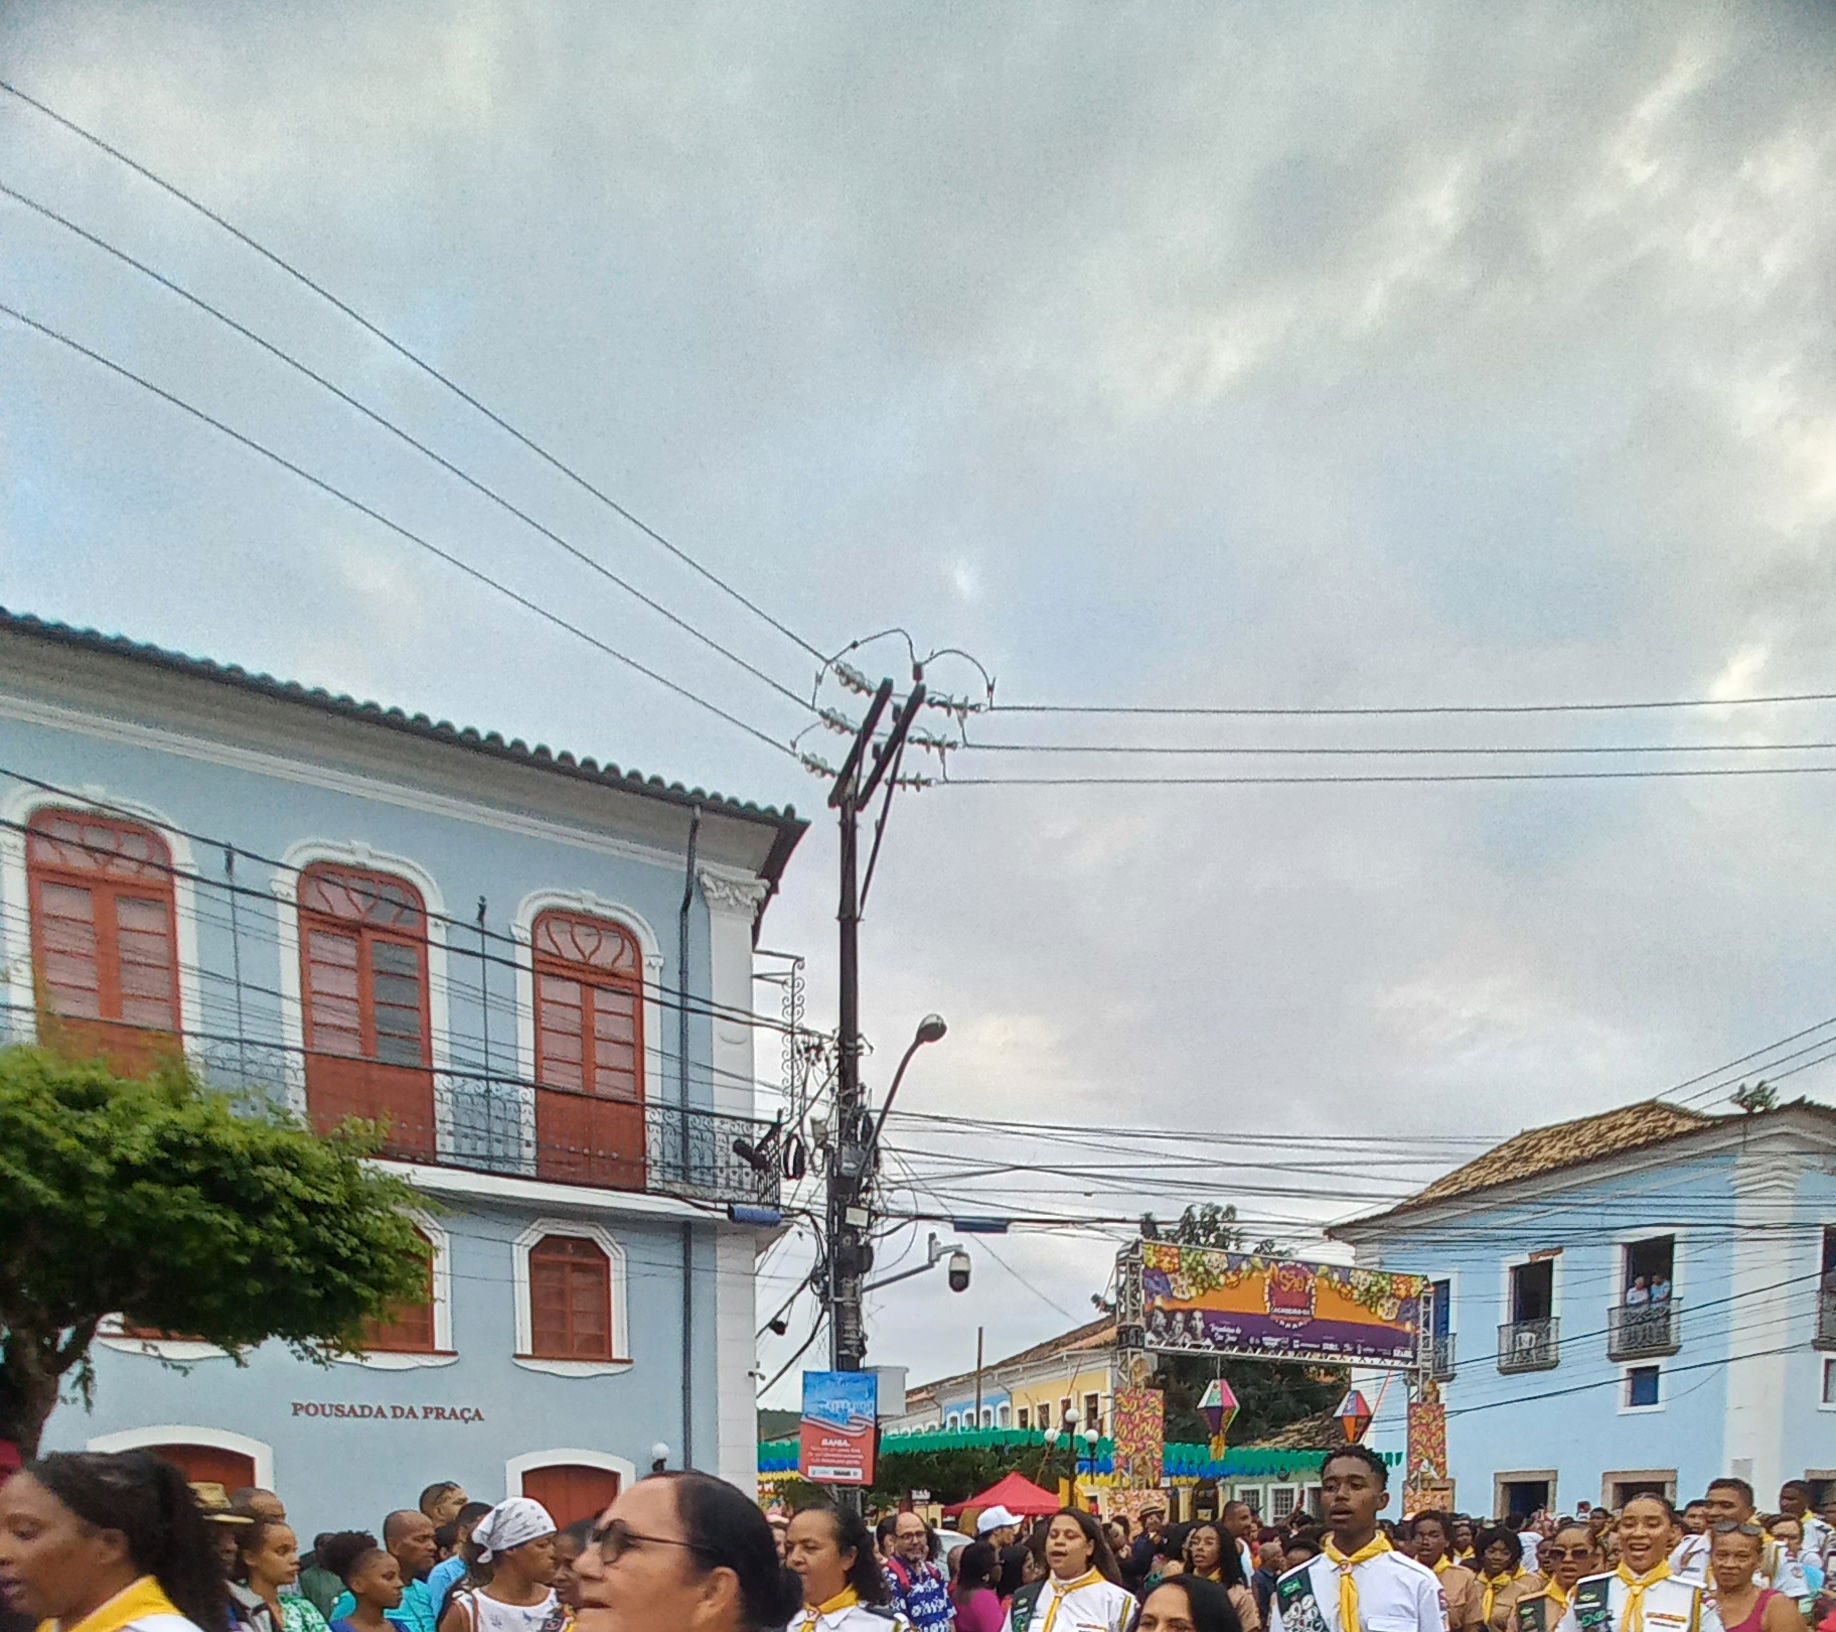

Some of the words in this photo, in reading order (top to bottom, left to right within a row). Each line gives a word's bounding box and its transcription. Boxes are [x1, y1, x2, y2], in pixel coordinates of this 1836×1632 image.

[291, 1402, 386, 1418] POUSADA
[390, 1405, 418, 1419] DA
[422, 1406, 485, 1424] PRAÇA
